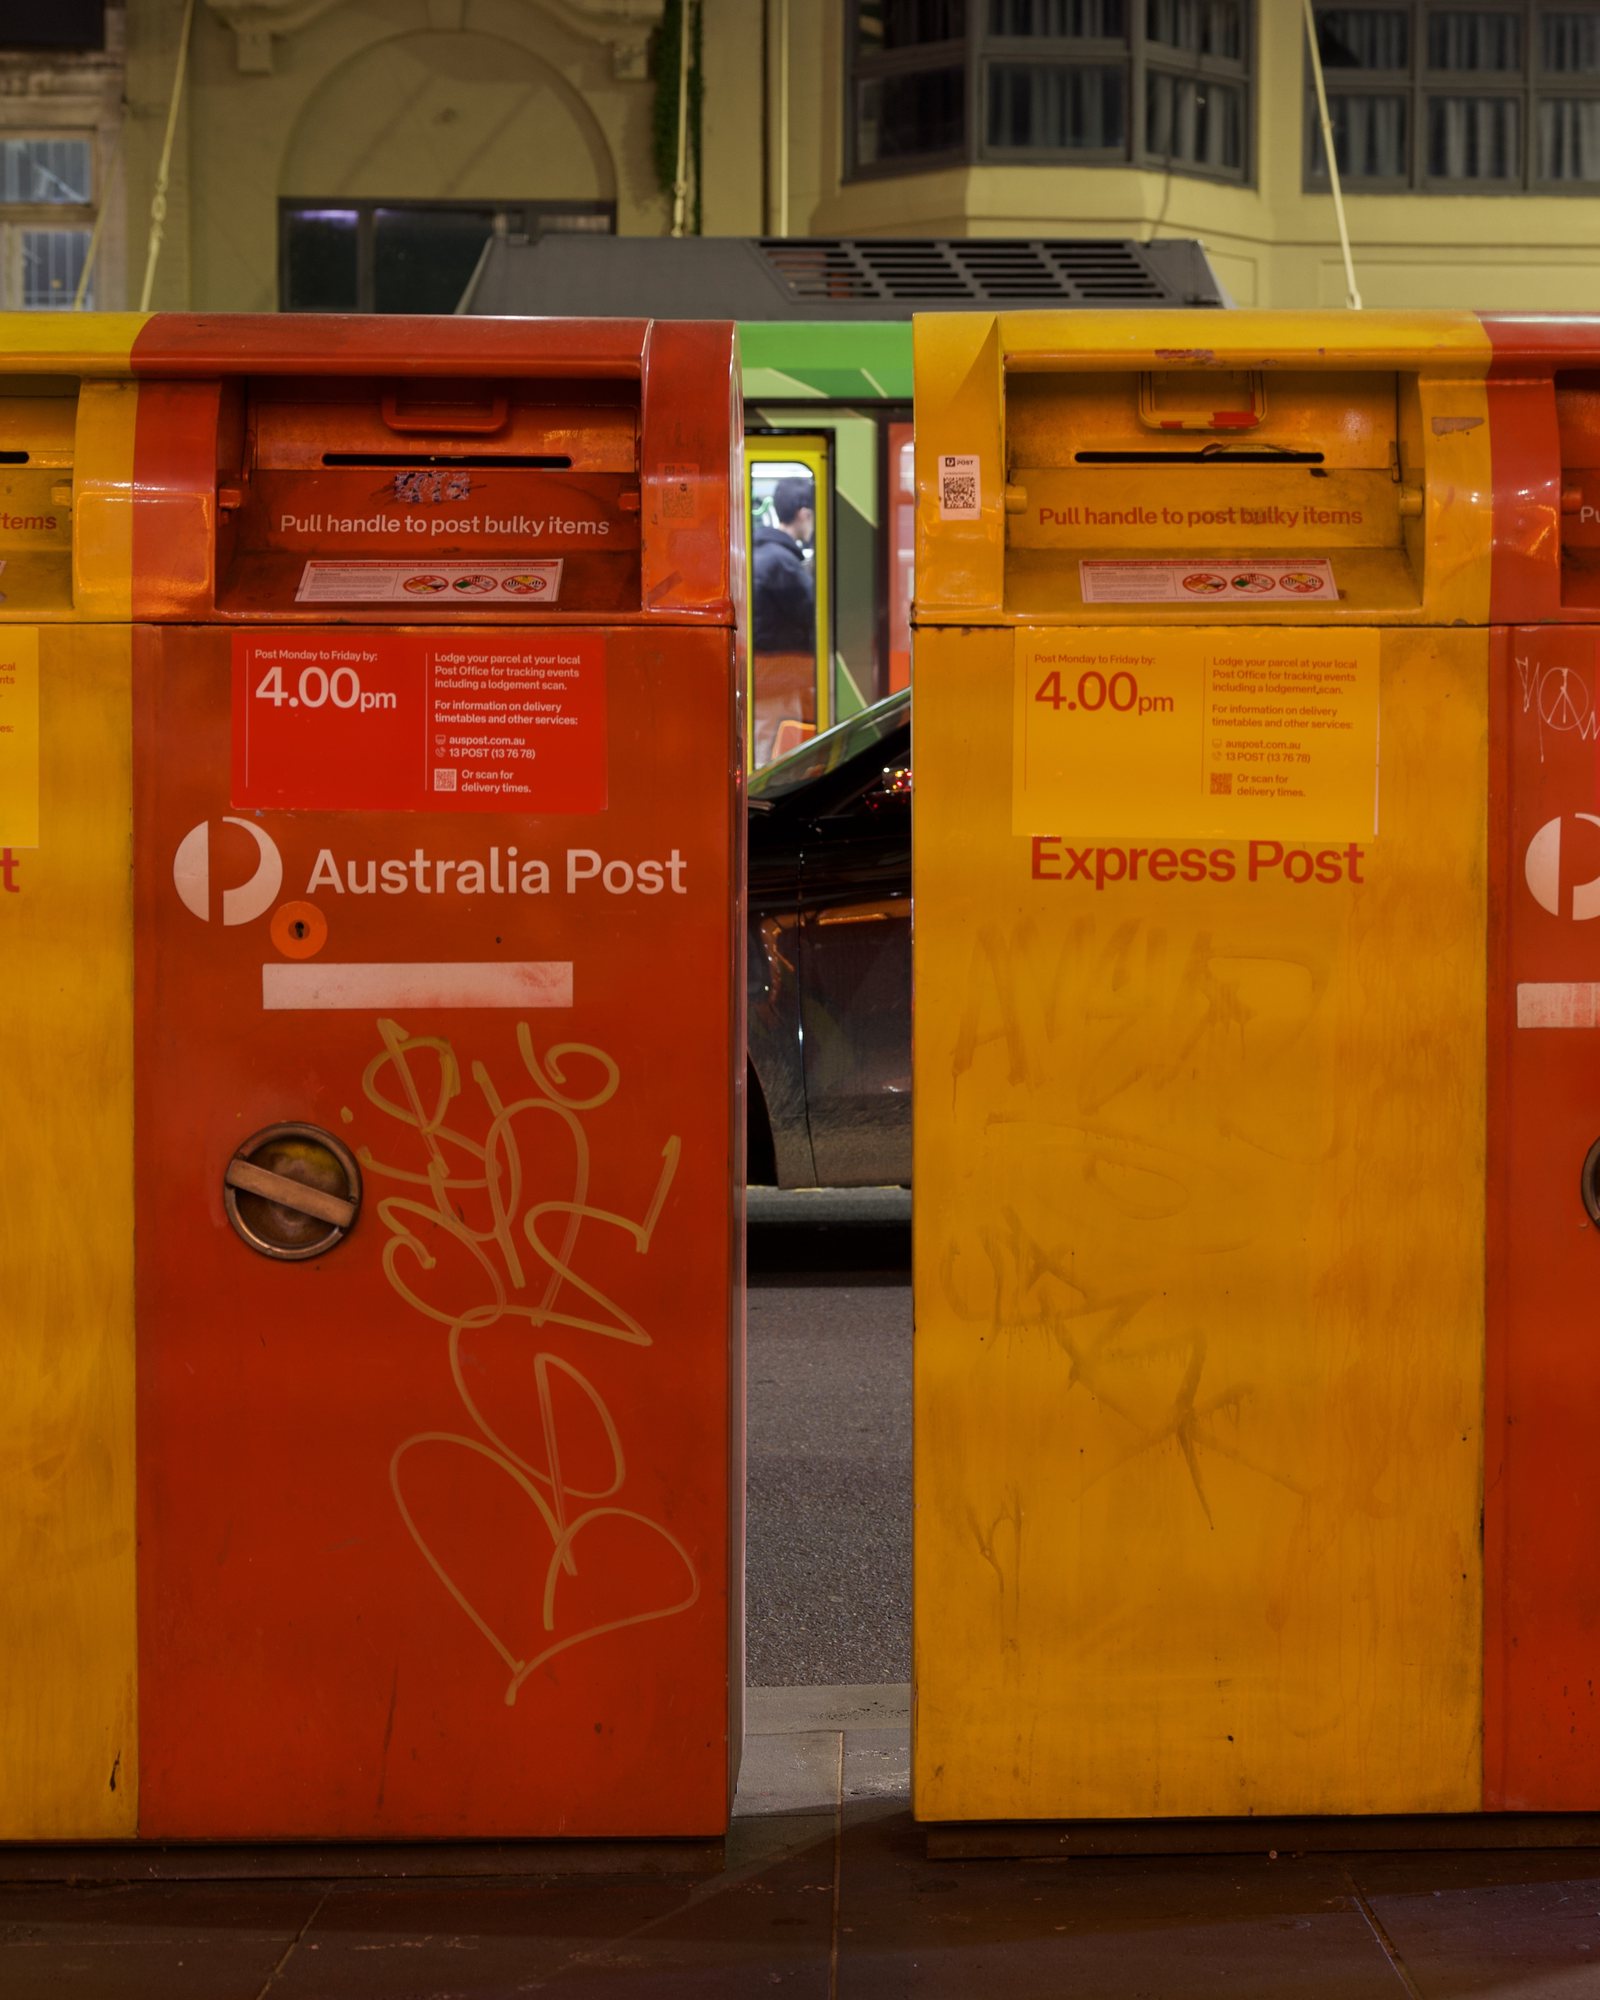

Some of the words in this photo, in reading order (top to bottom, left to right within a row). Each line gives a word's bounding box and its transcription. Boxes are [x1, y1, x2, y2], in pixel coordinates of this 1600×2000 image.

[0, 512, 57, 530] tems
[1039, 507, 1081, 526] Pull
[1085, 507, 1158, 525] handle
[1161, 508, 1184, 525] to
[1187, 507, 1237, 528] post
[1240, 506, 1299, 528] bulky
[1303, 506, 1363, 525] items
[280, 515, 322, 532] Pull
[326, 515, 400, 532] handle
[404, 516, 427, 532] to
[431, 516, 481, 537] post
[484, 515, 544, 537] bulky
[548, 516, 610, 535] items
[255, 650, 278, 659] Post
[279, 650, 317, 661] Monday
[319, 651, 330, 660] to
[331, 651, 361, 662] Friday
[362, 651, 378, 663] by:
[435, 652, 465, 664] Lodge
[467, 654, 488, 665] your
[490, 654, 521, 665] parcel
[522, 654, 532, 663] at
[534, 655, 555, 665] your
[557, 655, 581, 665] local
[1035, 654, 1057, 663] Post
[1058, 655, 1096, 665] Monday
[1099, 655, 1108, 663] to
[1110, 655, 1140, 666] Friday
[1141, 655, 1156, 666] by:
[1212, 656, 1243, 667] Lodge
[1244, 658, 1266, 668] your
[1268, 657, 1298, 668] parcel
[1300, 658, 1310, 667] at
[1312, 659, 1333, 669] your
[1334, 659, 1358, 669] local
[0, 662, 16, 671] cal
[434, 666, 458, 675] Post
[459, 666, 489, 676] Office
[491, 666, 504, 676] for
[506, 666, 545, 678] tracking
[546, 668, 580, 678] events
[1212, 670, 1235, 679] Post
[1236, 670, 1266, 680] Office
[1268, 670, 1282, 680] for
[1284, 671, 1323, 682] tracking
[1324, 672, 1357, 682] events
[255, 666, 397, 713] 4.00pm
[434, 678, 479, 690] including
[480, 680, 487, 689] a
[488, 679, 540, 691] lodgement
[541, 682, 567, 690] scan.
[1212, 682, 1256, 695] including
[1258, 684, 1264, 692] a
[1035, 671, 1174, 716] 4.00pm
[434, 700, 450, 709] For
[452, 700, 507, 710] information
[508, 702, 520, 711] on
[522, 701, 562, 713] delivery
[1212, 704, 1228, 713] For
[1229, 704, 1284, 714] information
[1285, 707, 1298, 715] on
[1299, 705, 1338, 717] delivery
[434, 713, 486, 723] timetables
[488, 714, 506, 724] and
[507, 714, 533, 724] other
[535, 716, 578, 725] services:
[1212, 718, 1263, 728] timetables
[1264, 718, 1282, 728] and
[1284, 718, 1309, 728] other
[1311, 720, 1353, 729] services:
[449, 736, 525, 745] auspost.com.au
[1225, 740, 1300, 750] auspost.com.au
[449, 748, 460, 757] 13
[461, 748, 489, 758] POST
[491, 748, 505, 759] (13
[507, 749, 520, 758] 76
[521, 748, 536, 759] 78)
[1225, 752, 1236, 761] 13
[1237, 753, 1265, 762] POST
[1266, 753, 1280, 763] (13
[1282, 753, 1295, 762] 76
[1296, 753, 1311, 764] 78)
[461, 770, 474, 779] Or
[475, 772, 499, 780] scan
[500, 770, 514, 780] for
[1237, 773, 1249, 783] Or
[1251, 775, 1273, 783] scan
[1275, 774, 1288, 783] for
[461, 783, 500, 794] delivery
[502, 783, 532, 793] times.
[1237, 787, 1275, 798] delivery
[1277, 787, 1306, 797] times.
[1031, 836, 1236, 891] Express
[1248, 840, 1365, 884] Post
[306, 846, 550, 894] Australia
[566, 849, 687, 894] Post
